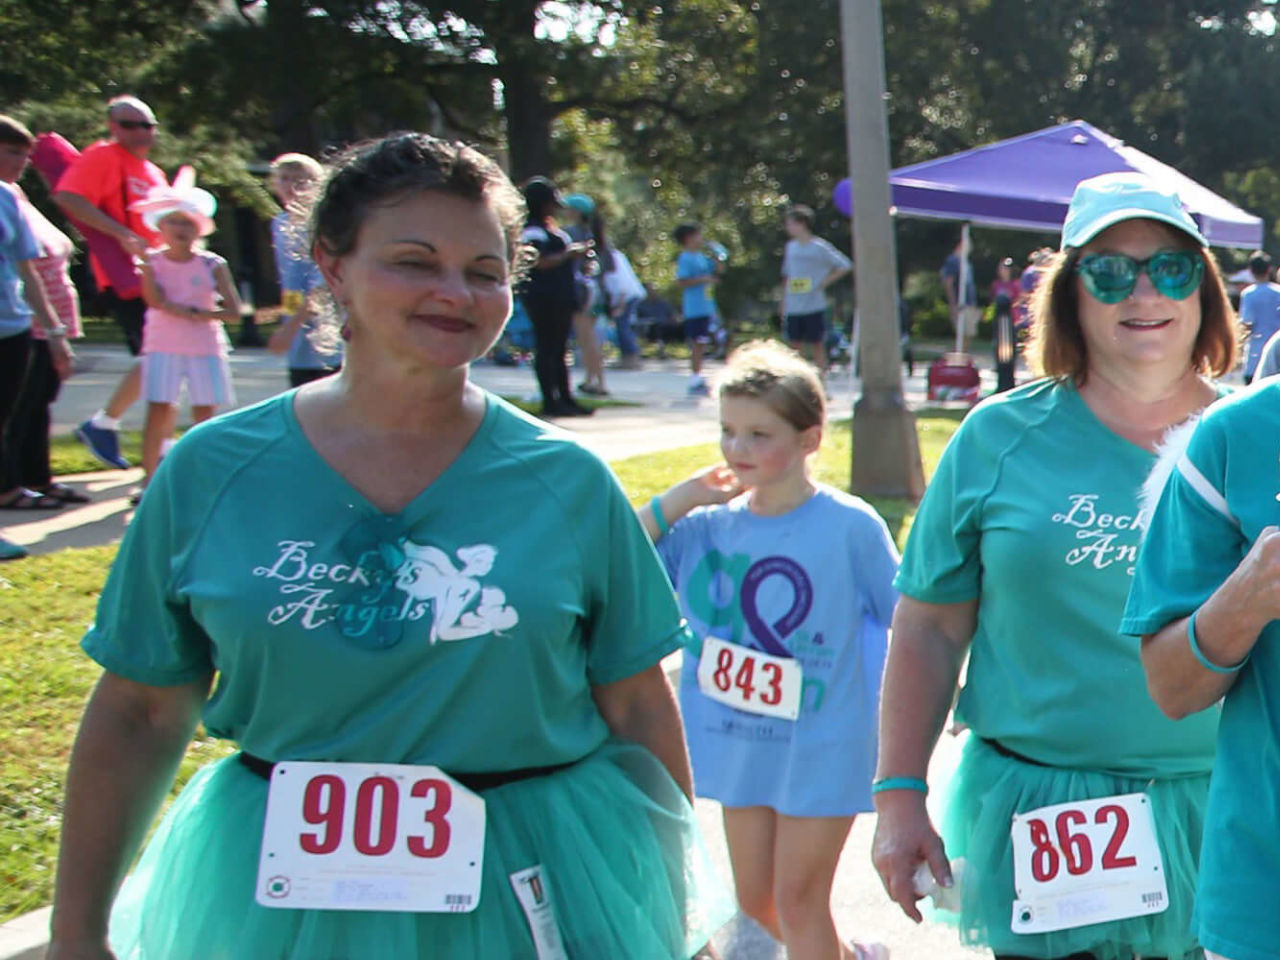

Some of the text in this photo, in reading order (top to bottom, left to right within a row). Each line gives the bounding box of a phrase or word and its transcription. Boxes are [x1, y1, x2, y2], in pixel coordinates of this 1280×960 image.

[267, 582, 430, 637] Angels
[713, 648, 784, 706] 843
[299, 773, 453, 859] 903
[1026, 804, 1137, 883] 862
